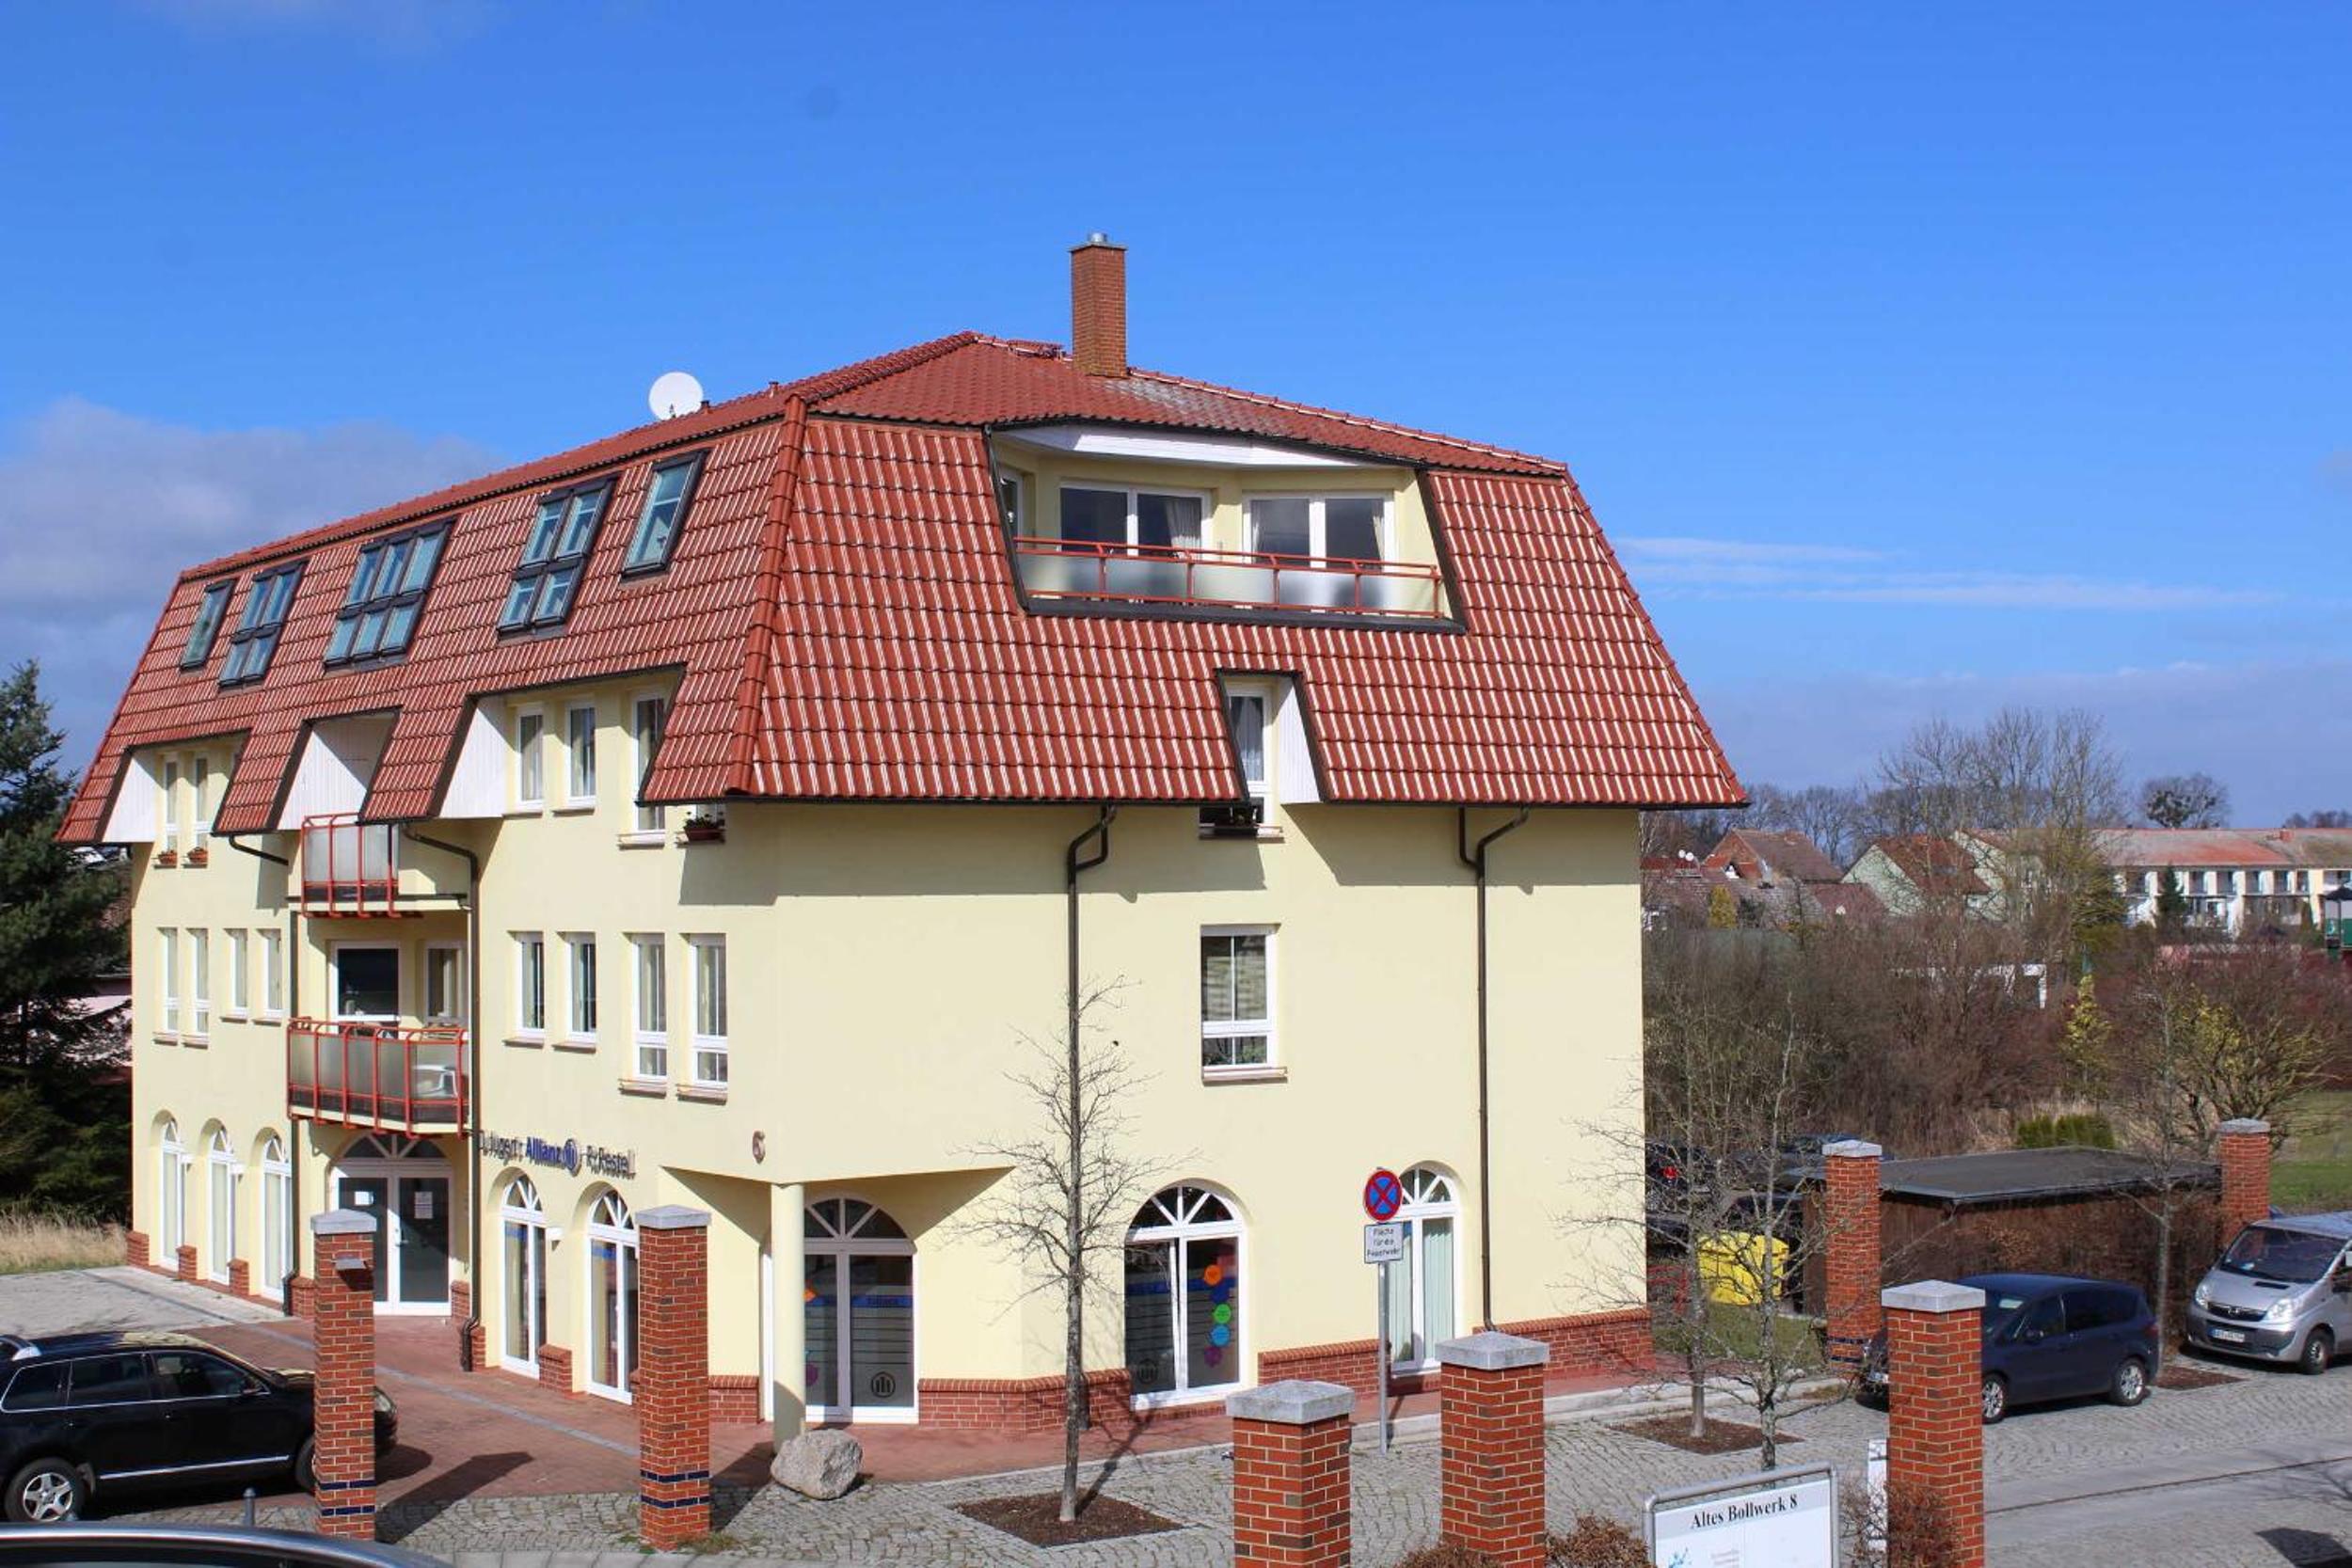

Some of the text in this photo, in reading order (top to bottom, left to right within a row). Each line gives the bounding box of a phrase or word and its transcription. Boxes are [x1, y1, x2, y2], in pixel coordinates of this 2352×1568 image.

[526, 1136, 564, 1167] Allianz
[753, 1131, 765, 1164] 6
[1691, 1494, 1798, 1528] Altes Bollwerk 8
